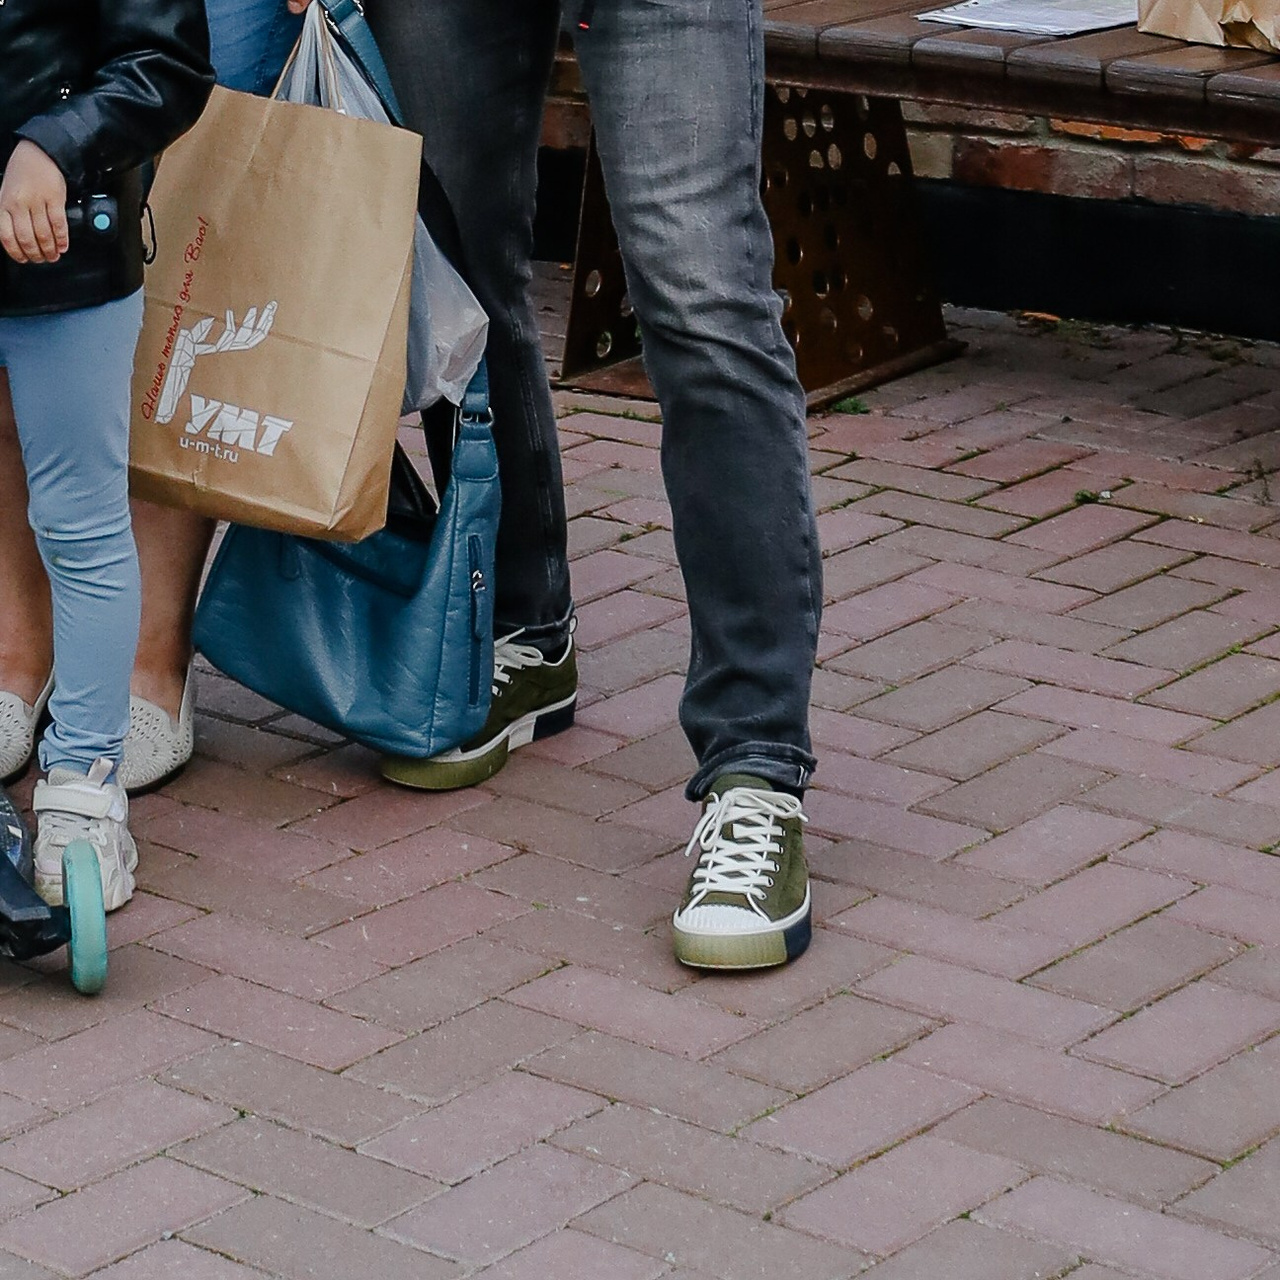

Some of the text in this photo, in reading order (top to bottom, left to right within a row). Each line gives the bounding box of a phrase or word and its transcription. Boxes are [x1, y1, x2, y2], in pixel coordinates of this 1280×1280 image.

[141, 216, 209, 420] Наше тепло для Вас!
[179, 436, 239, 463] u-m-t.ru
